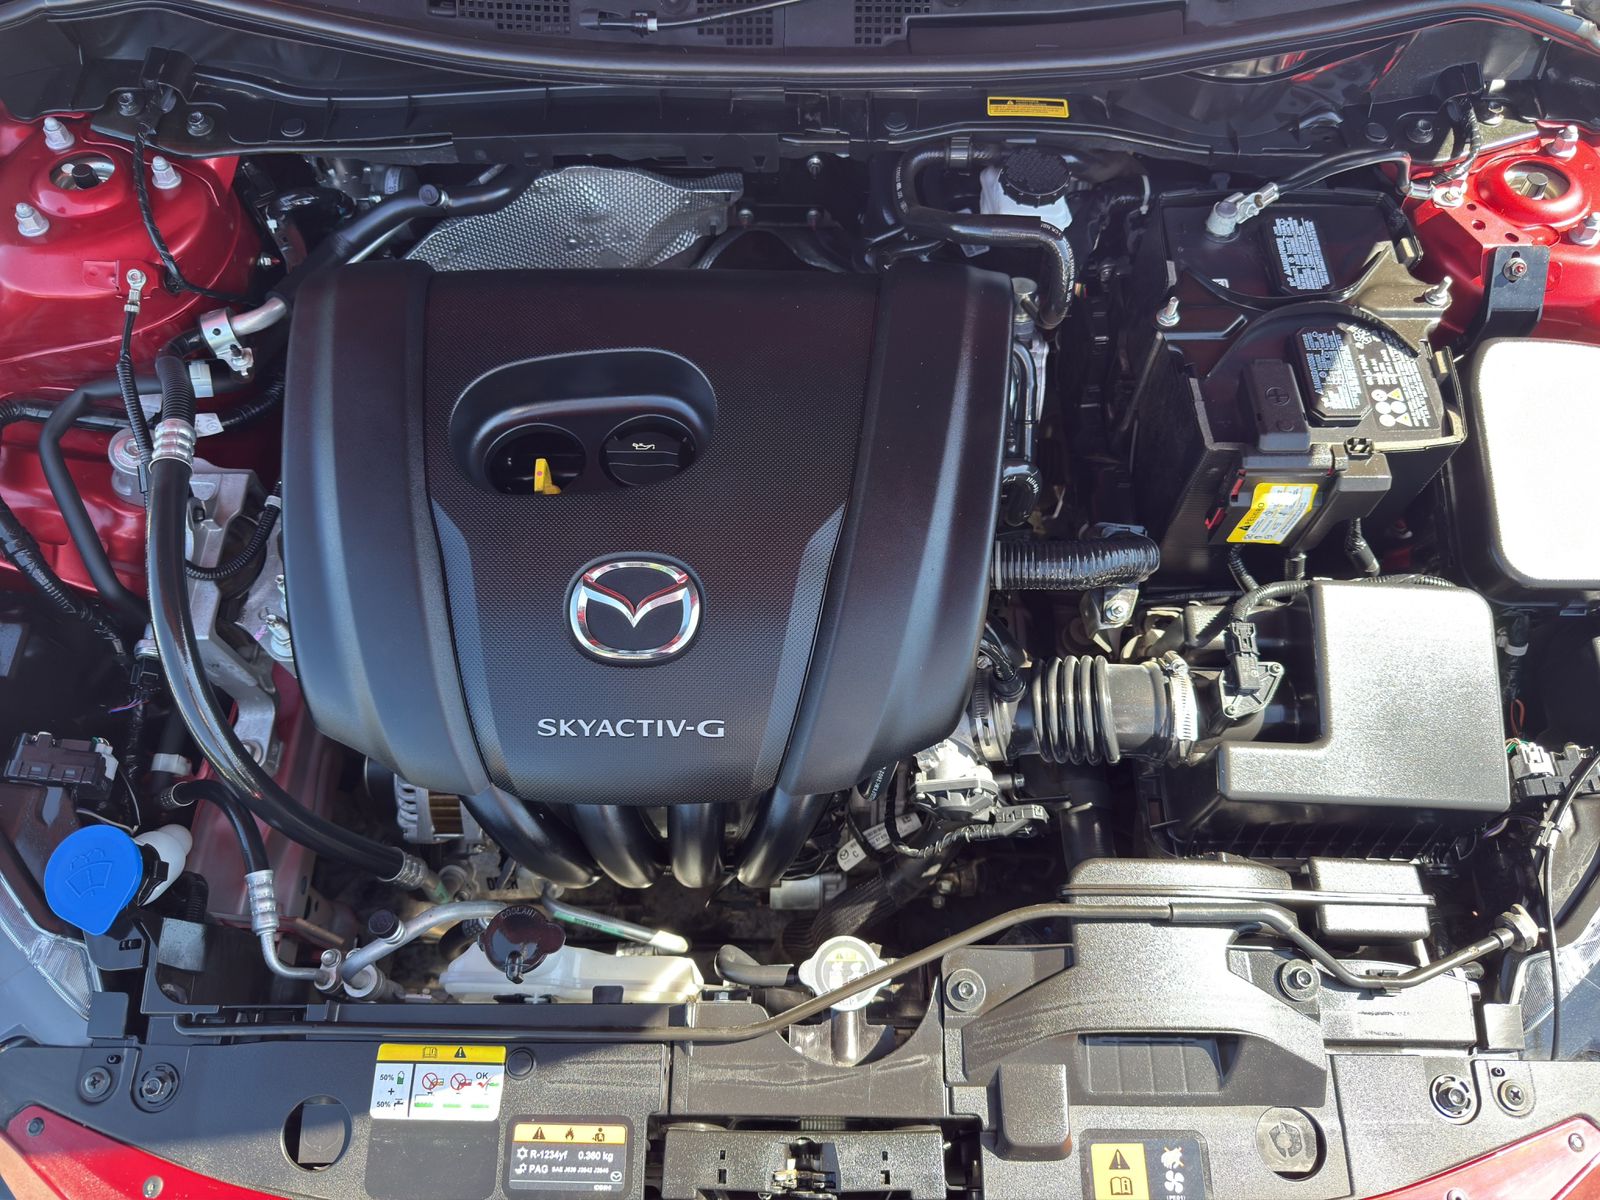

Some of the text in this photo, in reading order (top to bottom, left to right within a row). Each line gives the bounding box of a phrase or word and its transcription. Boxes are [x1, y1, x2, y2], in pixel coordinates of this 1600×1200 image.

[537, 718, 725, 738] SKYACTIV-G
[500, 906, 537, 919] COOLANT
[379, 1073, 395, 1081] 50%
[476, 1072, 488, 1080] OK
[376, 1101, 391, 1109] 50%
[530, 1149, 568, 1161] R-1234yf
[602, 1151, 614, 1162] kg
[528, 1165, 548, 1174] PAG
